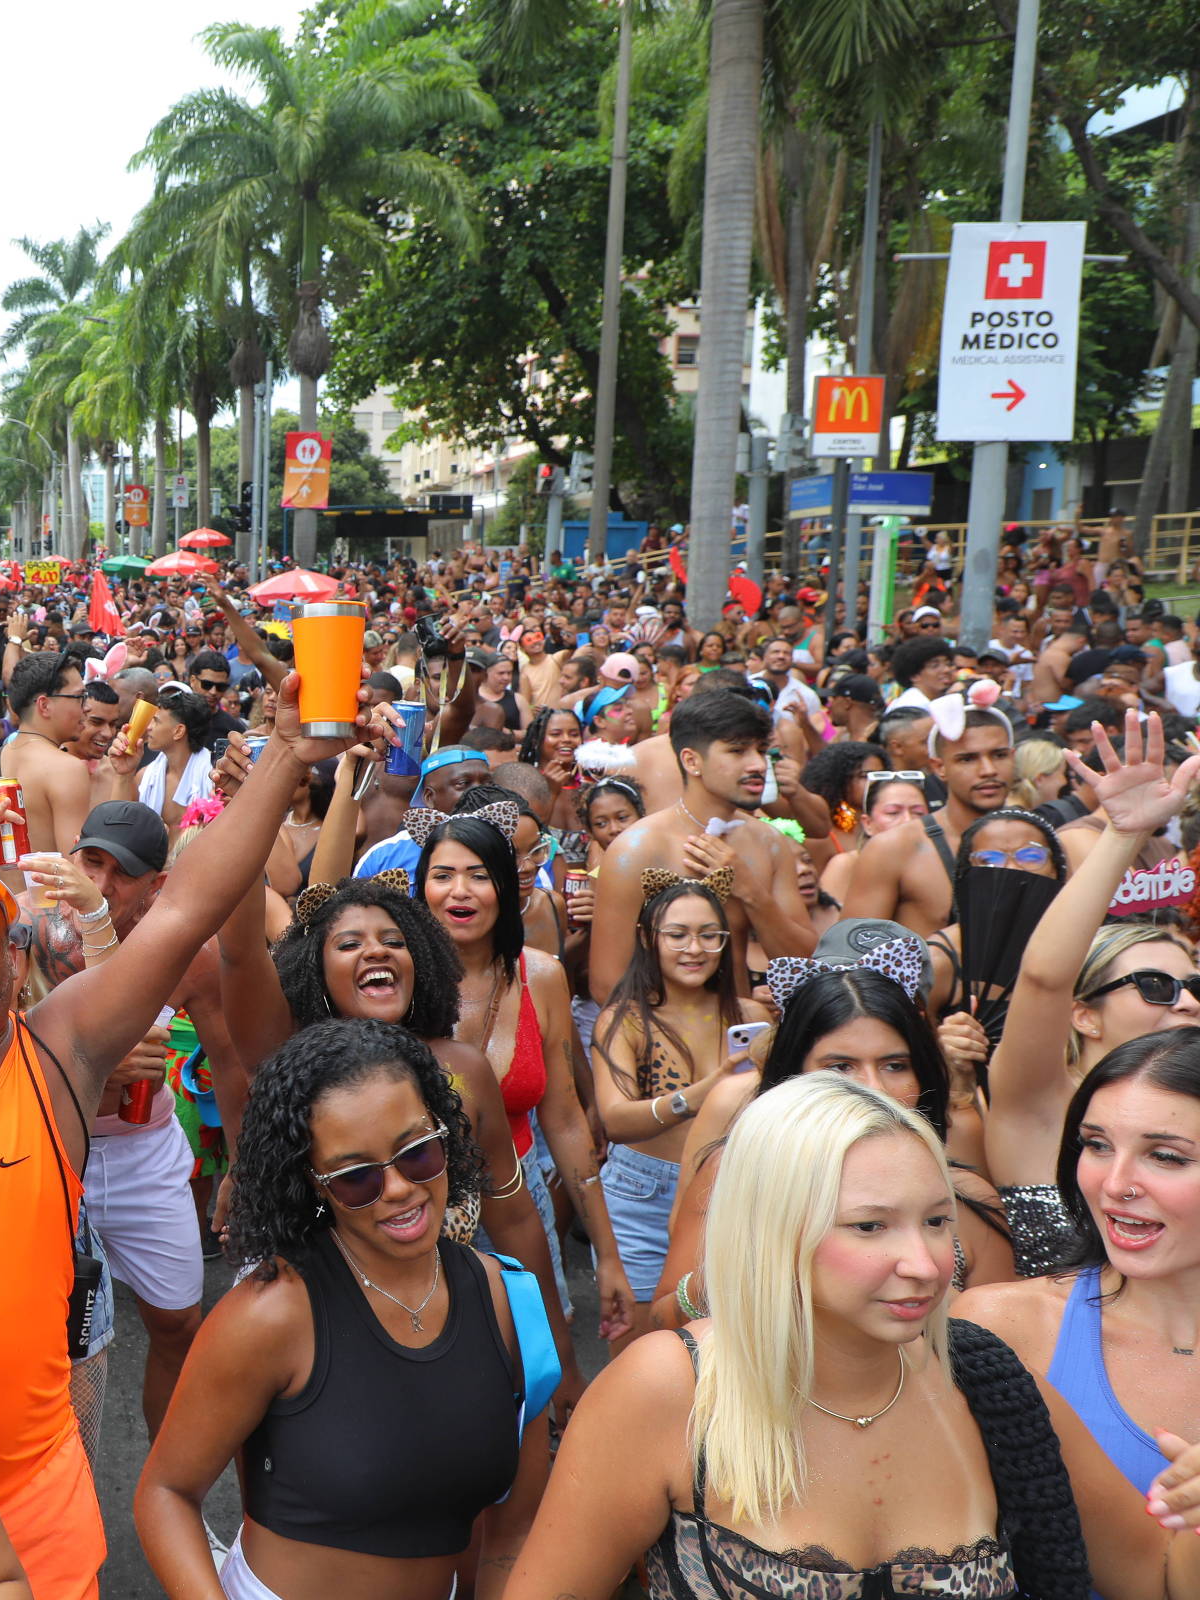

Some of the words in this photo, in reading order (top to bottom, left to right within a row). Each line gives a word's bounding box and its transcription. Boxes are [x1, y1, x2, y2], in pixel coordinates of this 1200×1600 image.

[971, 311, 1053, 328] POSTO
[961, 328, 1059, 350] MÉDICO
[952, 357, 999, 366] MEDICAL
[1002, 354, 1065, 365] ASSISTANCE
[79, 1289, 96, 1346] SCHUTZ
